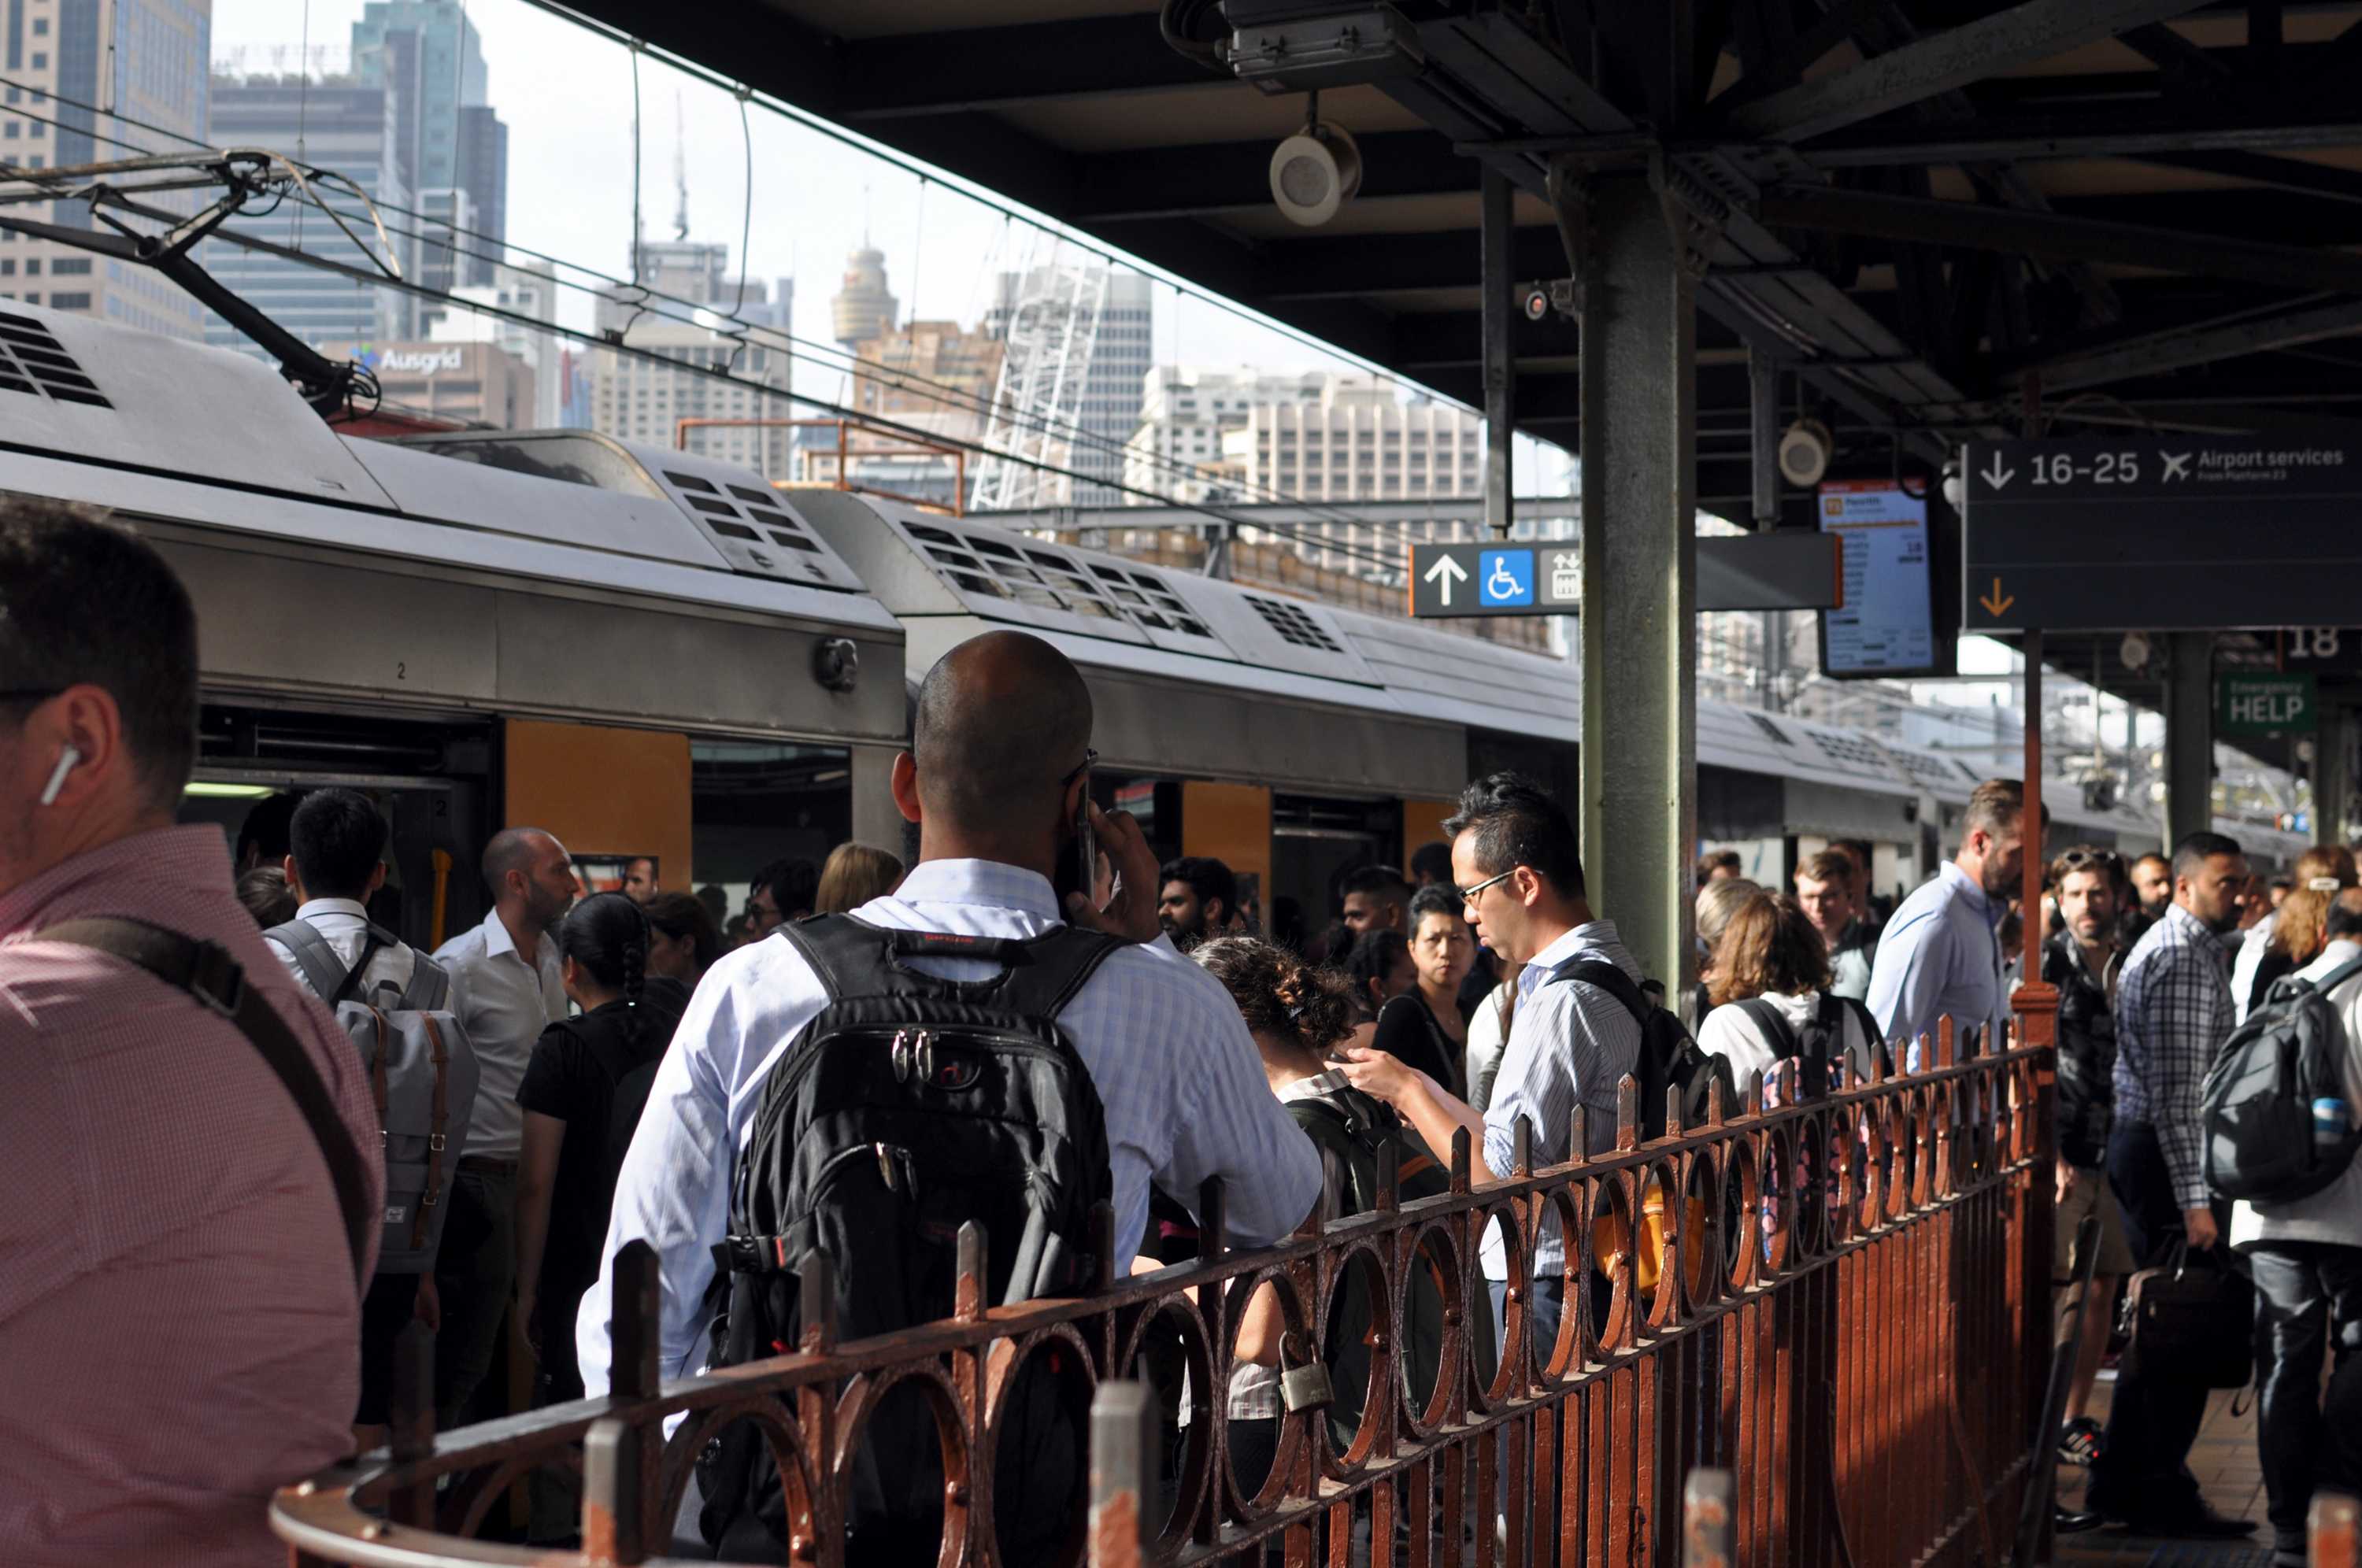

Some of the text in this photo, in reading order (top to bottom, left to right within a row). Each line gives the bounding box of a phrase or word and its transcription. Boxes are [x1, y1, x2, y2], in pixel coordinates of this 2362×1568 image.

[380, 346, 462, 375] Ausgrid
[2030, 451, 2140, 486] 16-25
[2197, 446, 2345, 469] Airport services
[2289, 626, 2339, 658] 18
[397, 662, 405, 680] 2
[2230, 695, 2305, 723] HELP
[435, 799, 447, 817] 2
